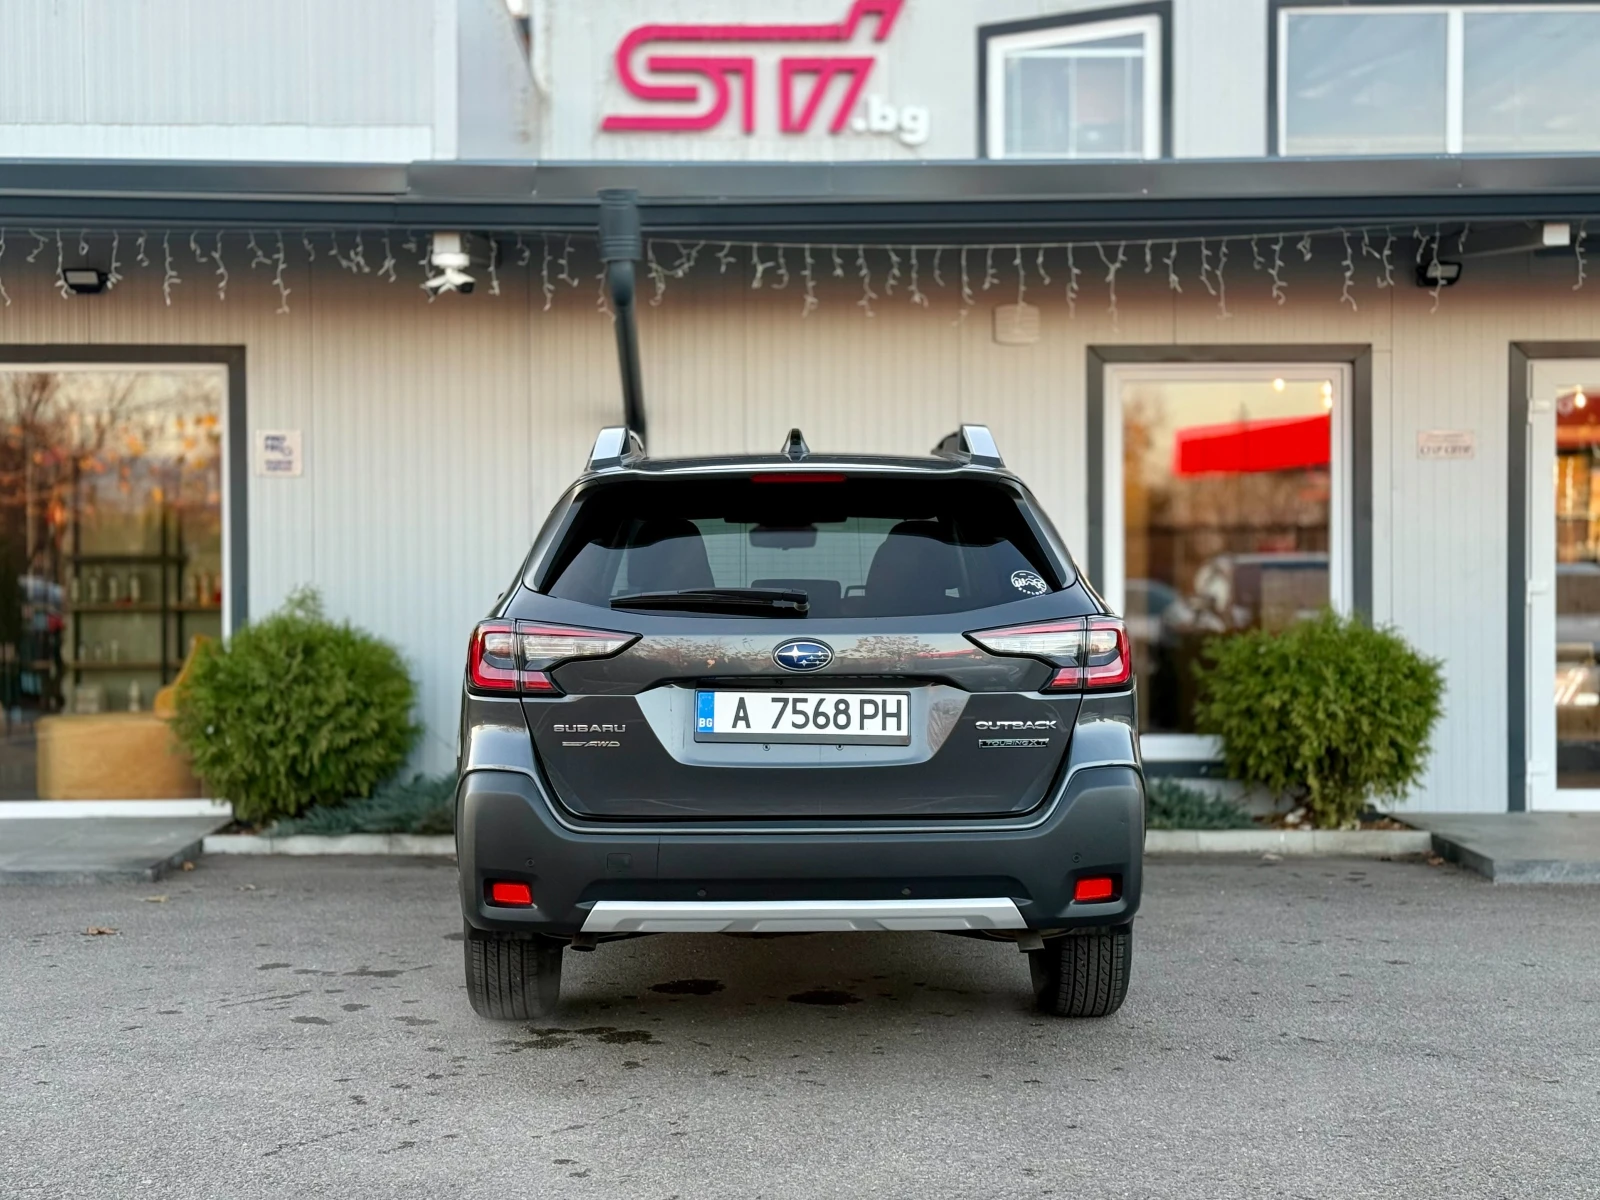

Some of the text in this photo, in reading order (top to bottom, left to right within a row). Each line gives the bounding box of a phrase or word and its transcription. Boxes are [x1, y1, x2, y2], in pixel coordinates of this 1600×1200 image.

[731, 696, 751, 729] A
[698, 717, 713, 728] BG
[975, 720, 1057, 730] OUTBACK
[553, 724, 626, 733] SUBARU
[584, 740, 620, 748] AWD
